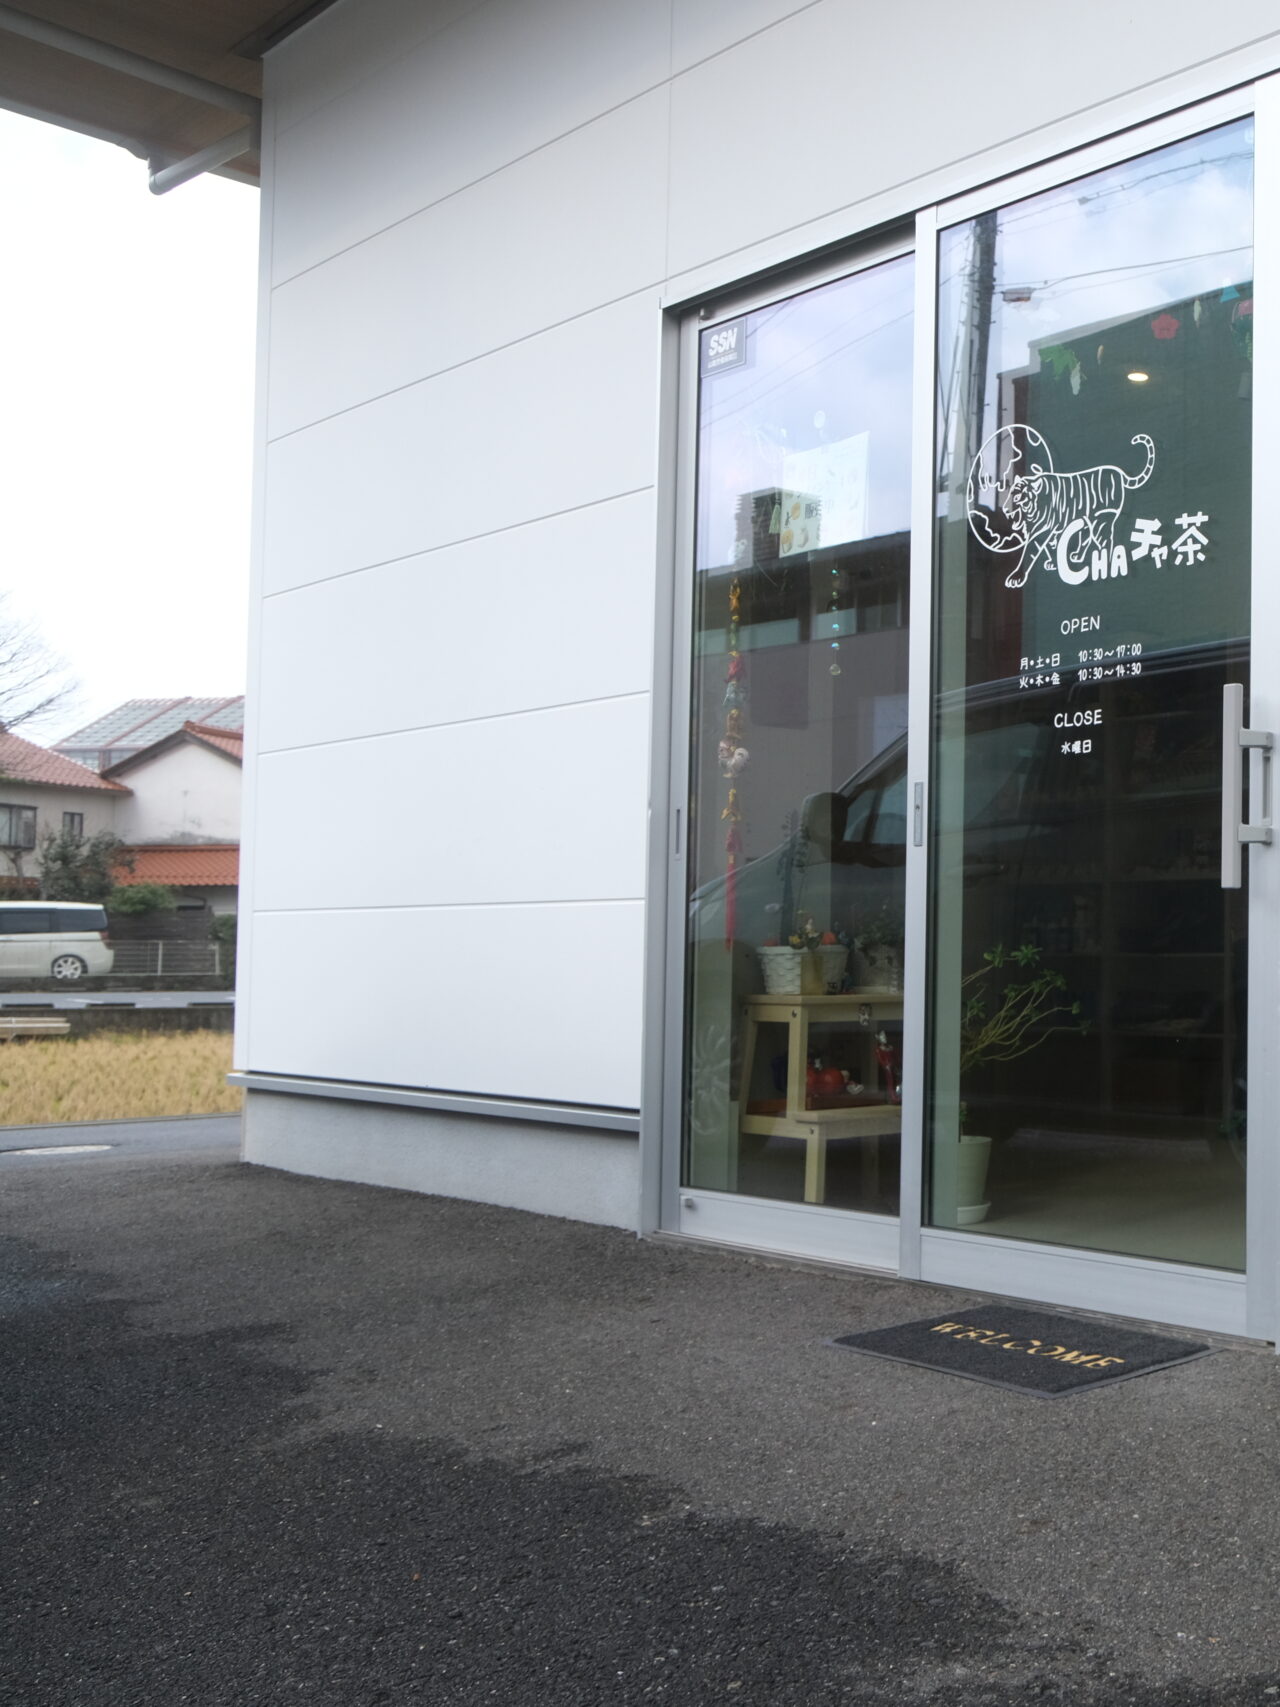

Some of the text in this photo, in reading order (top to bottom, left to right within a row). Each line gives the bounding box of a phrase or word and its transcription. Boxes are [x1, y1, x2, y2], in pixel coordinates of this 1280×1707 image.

[708, 327, 738, 356] SSN
[1056, 518, 1128, 585] CHA
[1060, 615, 1100, 635] OPEN
[1053, 709, 1103, 728] CLOSE
[1061, 739, 1092, 755] 水曜日
[928, 1321, 1127, 1370] WELCOME
